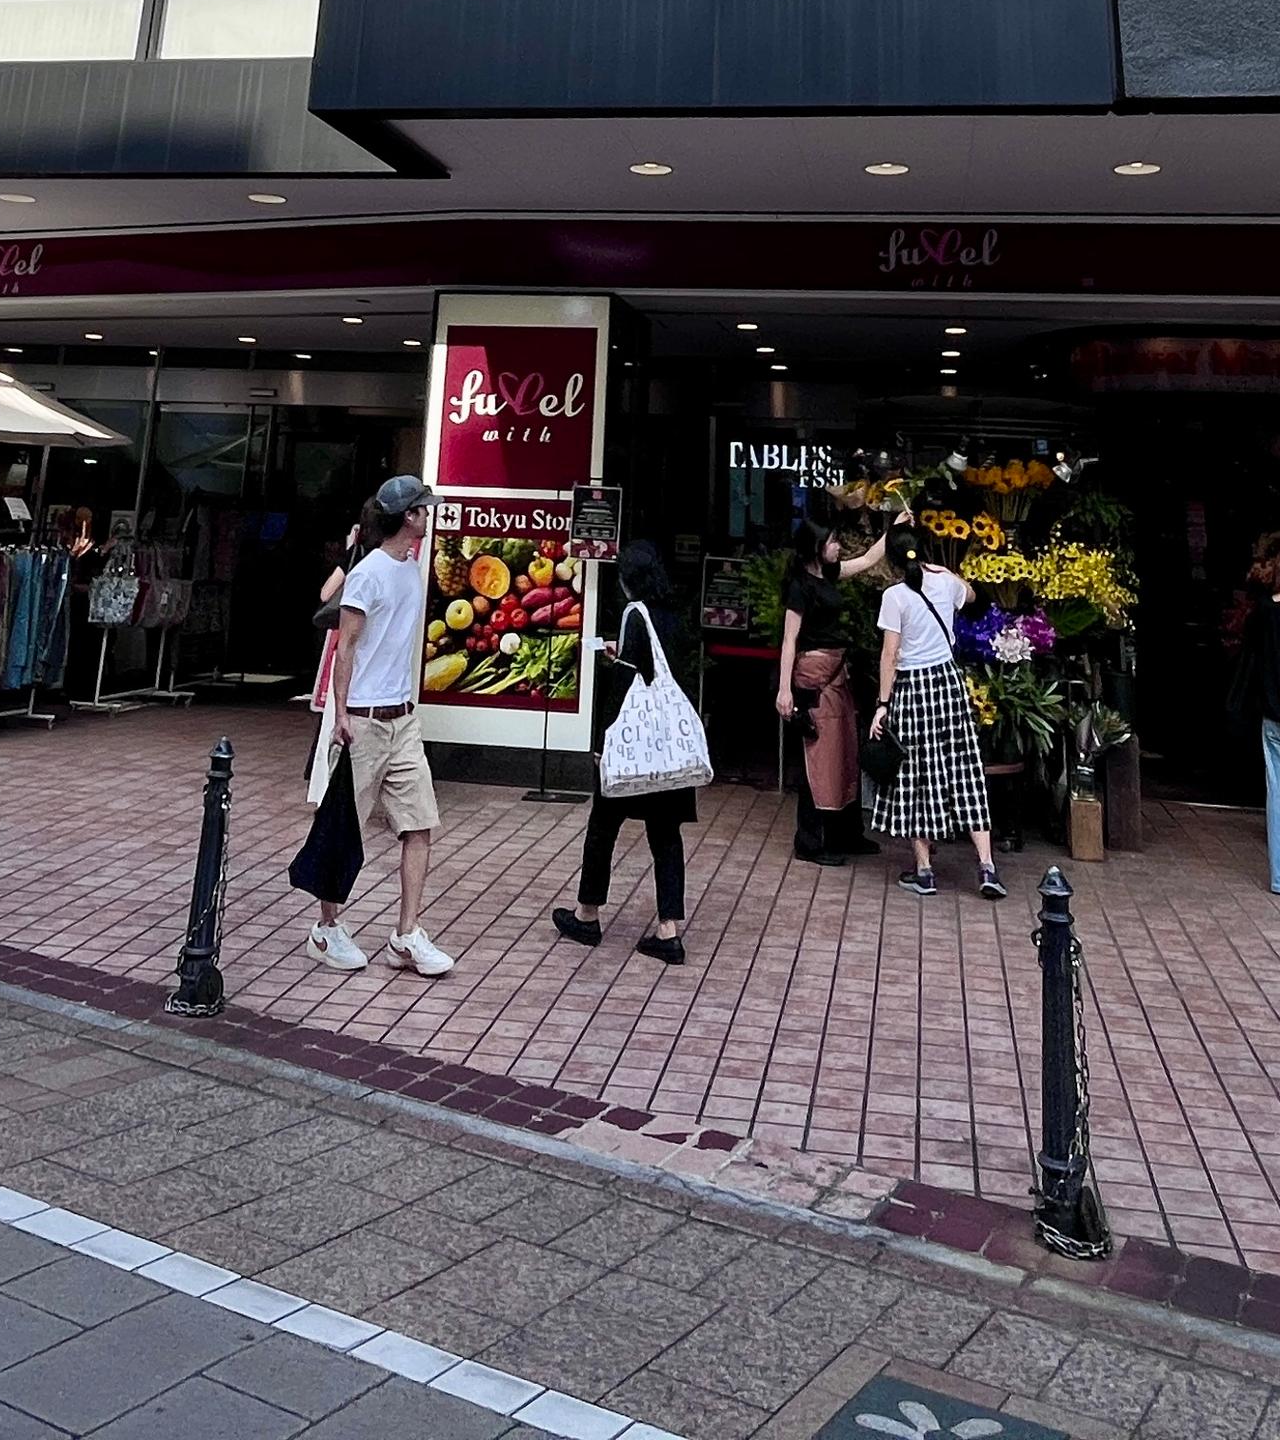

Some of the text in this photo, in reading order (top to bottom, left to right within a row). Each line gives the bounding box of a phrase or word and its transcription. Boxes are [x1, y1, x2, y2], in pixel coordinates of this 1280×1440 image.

[481, 425, 552, 445] with
[729, 441, 833, 472] TABLES
[464, 506, 527, 533] Tokyu
[531, 508, 573, 531] Stor
